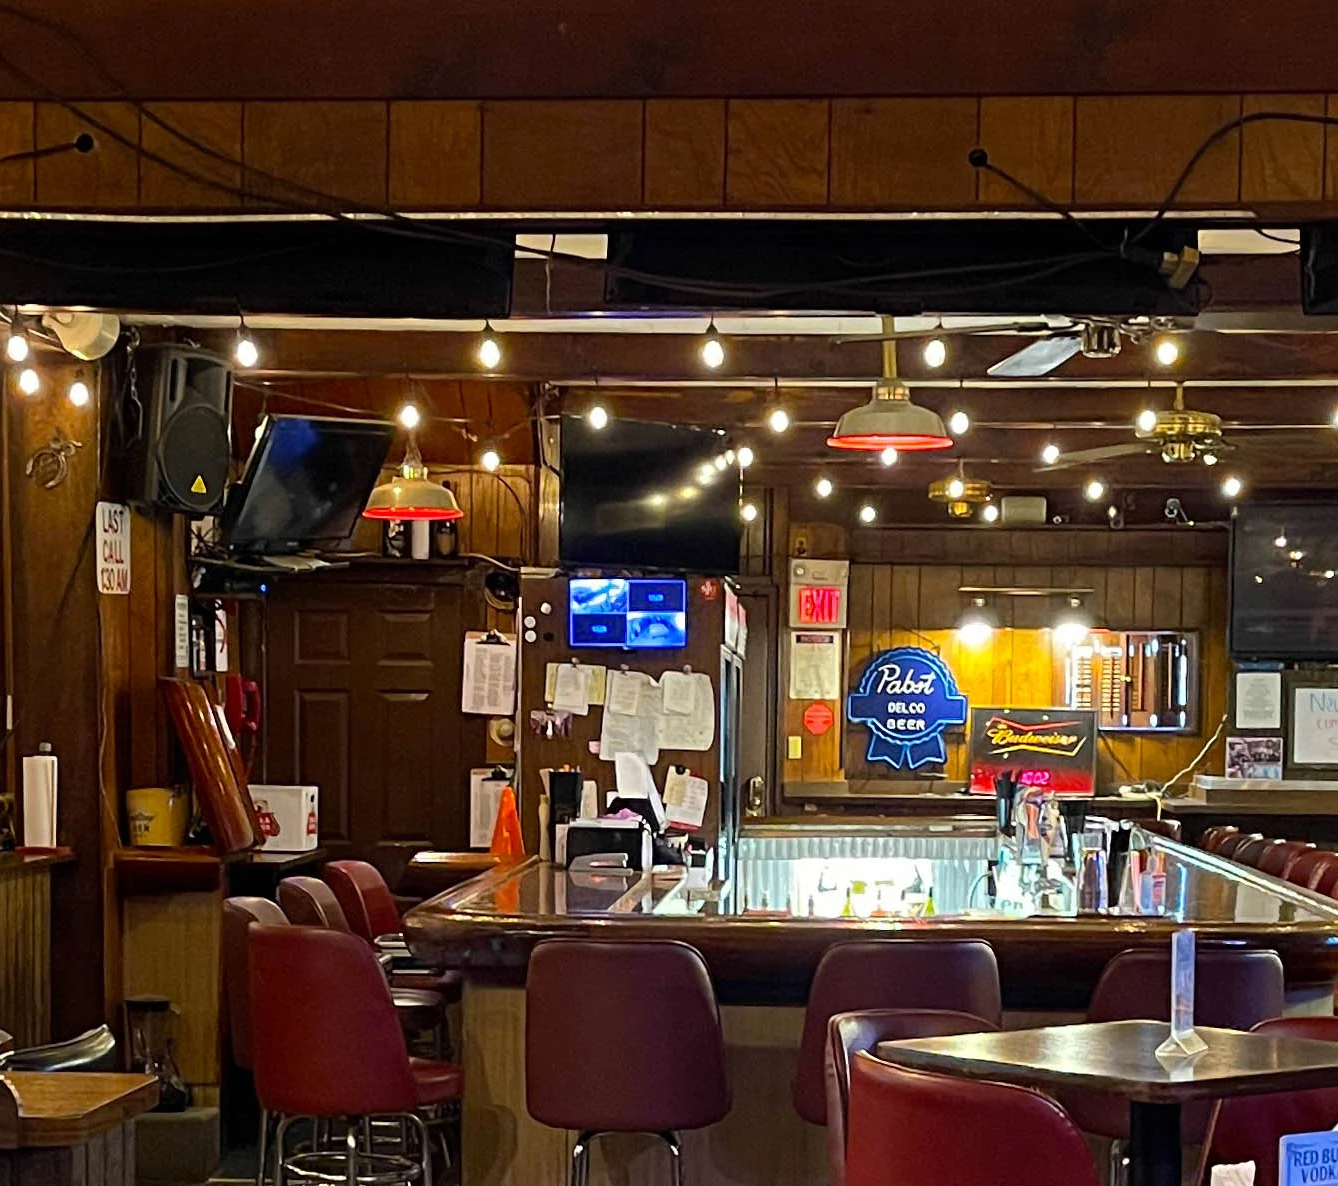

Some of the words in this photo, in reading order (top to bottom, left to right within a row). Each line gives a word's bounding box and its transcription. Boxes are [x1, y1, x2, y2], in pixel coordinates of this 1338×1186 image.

[102, 509, 124, 534] LAST
[103, 539, 124, 564] CALL
[798, 587, 842, 623] EXIT
[876, 663, 937, 695] Pabst
[887, 702, 925, 714] DELCO
[886, 719, 926, 730] BEER
[987, 727, 1078, 746] Budweiser
[1294, 1150, 1319, 1167] RED
